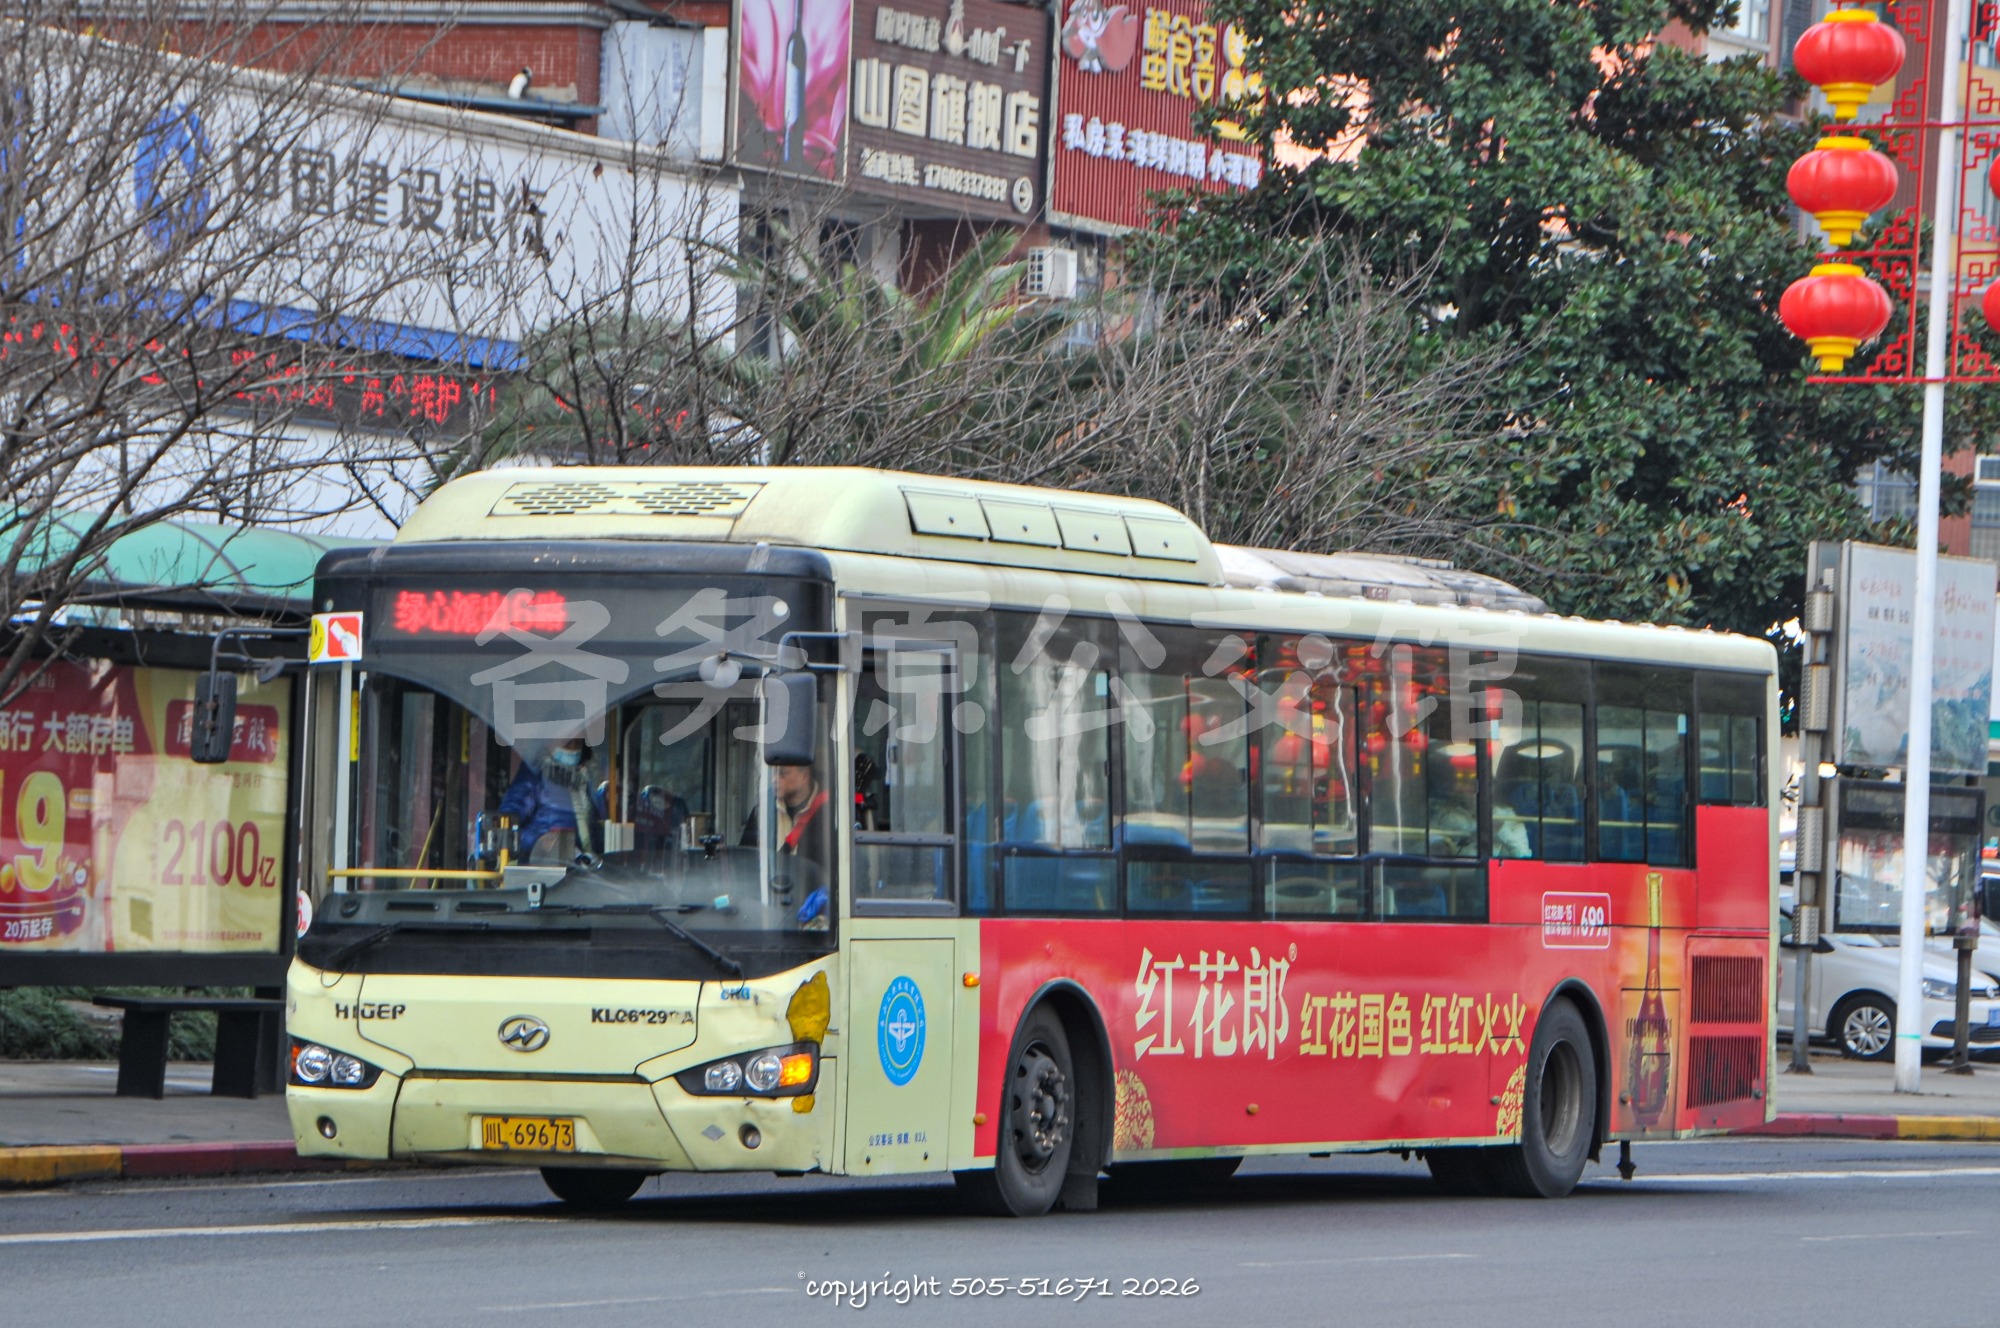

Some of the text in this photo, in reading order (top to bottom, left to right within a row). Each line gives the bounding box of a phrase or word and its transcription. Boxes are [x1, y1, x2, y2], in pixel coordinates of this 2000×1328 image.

[854, 56, 1039, 159] 山图旗舰店
[1208, 148, 1264, 190] 小酒馆
[42, 709, 135, 755] 大额存单
[161, 818, 277, 888] 2100亿
[4, 917, 53, 938] 20万起存
[335, 1002, 406, 1020] HIGER
[591, 1008, 695, 1025] KLQ629A
[1135, 946, 1291, 1062] 红花郎
[1299, 991, 1526, 1060] 红花国色 红红火火
